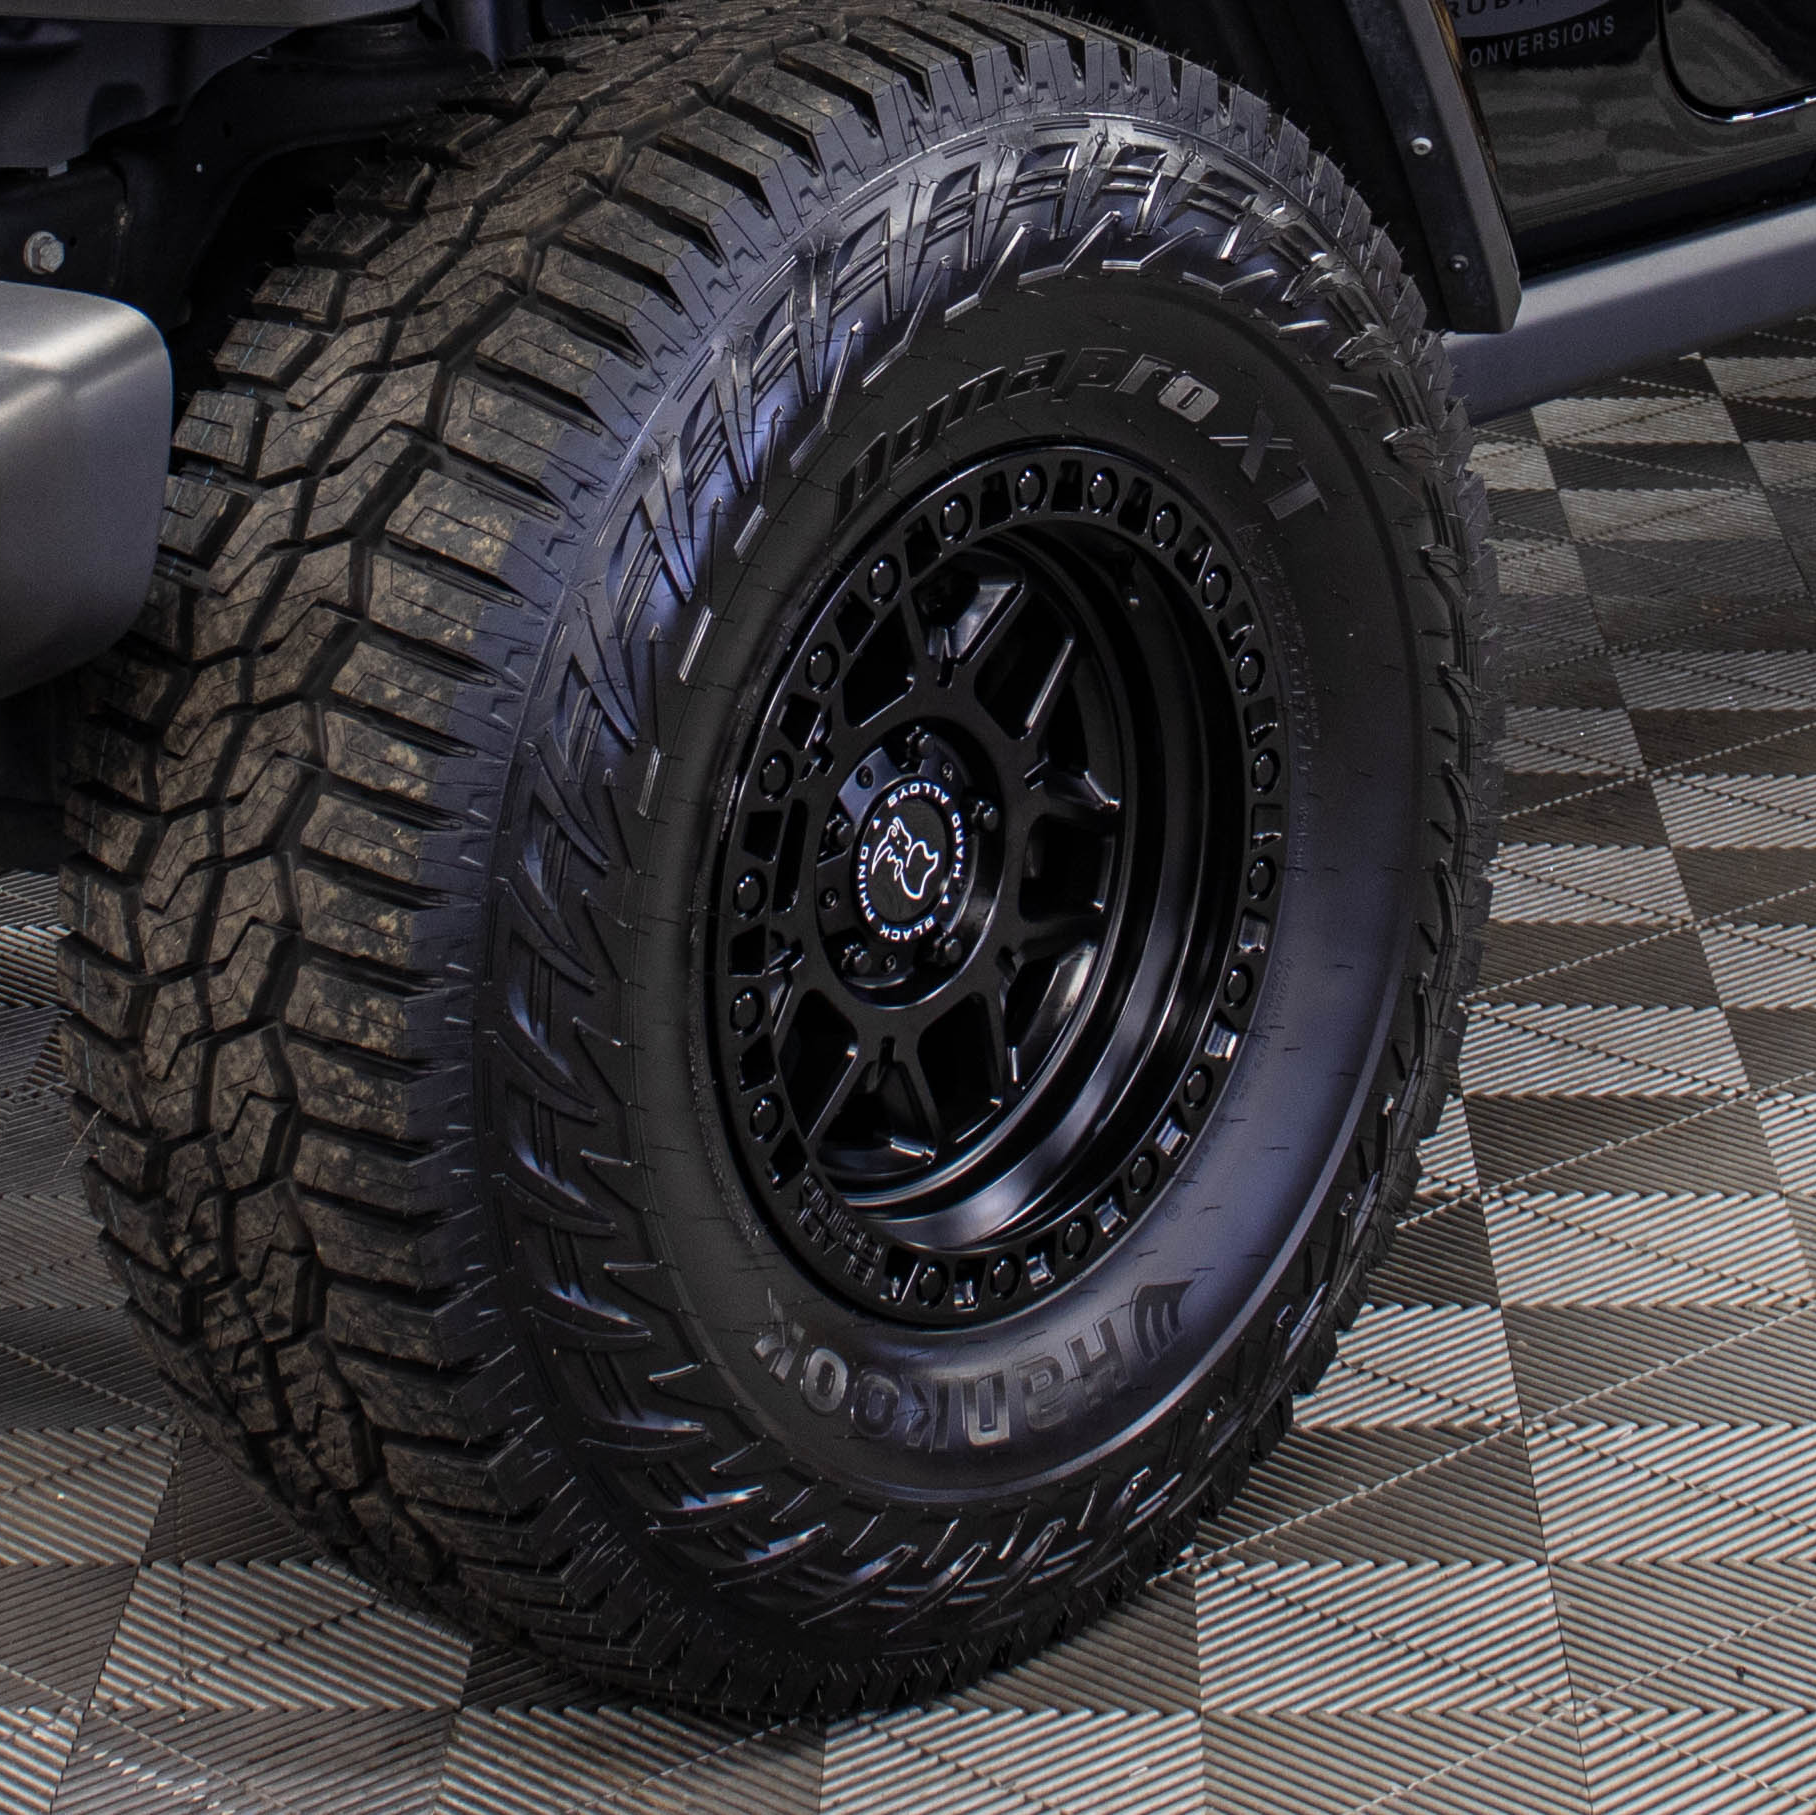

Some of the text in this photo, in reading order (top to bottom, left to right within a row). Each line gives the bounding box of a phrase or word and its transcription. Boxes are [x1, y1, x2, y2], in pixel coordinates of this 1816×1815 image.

[1469, 15, 1616, 68] ONVERSIONS
[835, 348, 1330, 528] Dynapro XT
[887, 782, 965, 878] HARD ALLOYS
[857, 845, 935, 941] BLACK RHINO
